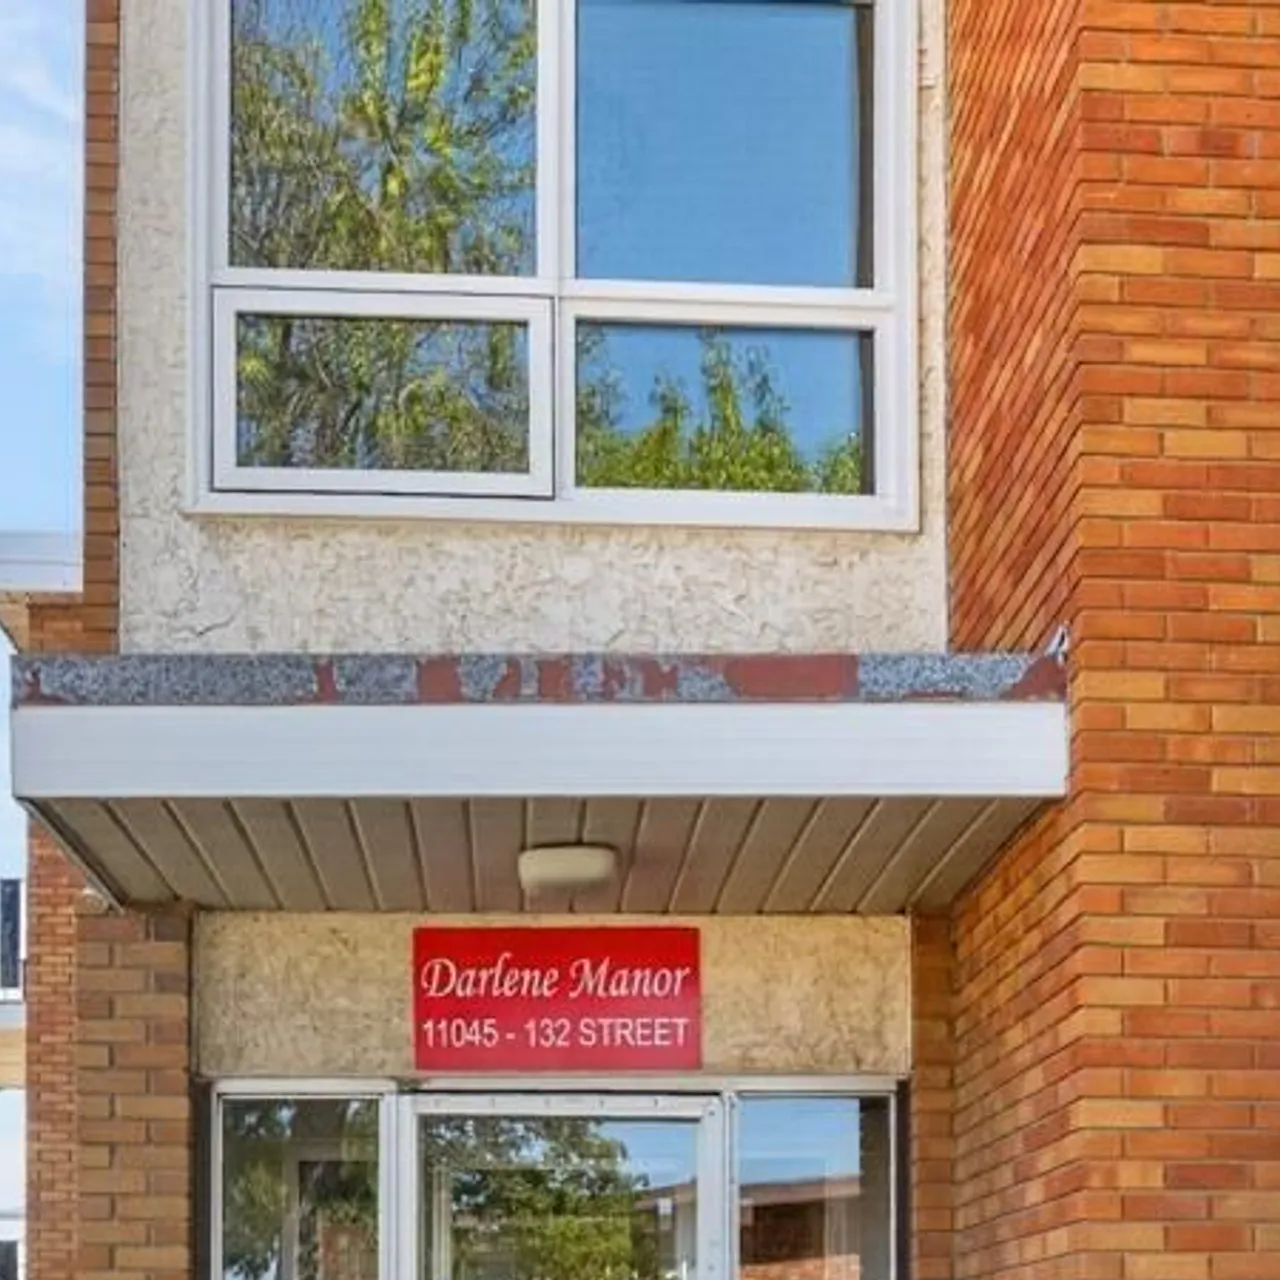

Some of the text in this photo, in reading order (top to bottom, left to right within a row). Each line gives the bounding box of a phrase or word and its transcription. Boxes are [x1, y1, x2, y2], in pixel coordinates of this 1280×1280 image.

[420, 953, 691, 998] Darlene Manor
[423, 1018, 499, 1048] 11045
[523, 1018, 570, 1047] 132
[579, 1017, 690, 1046] STREET
